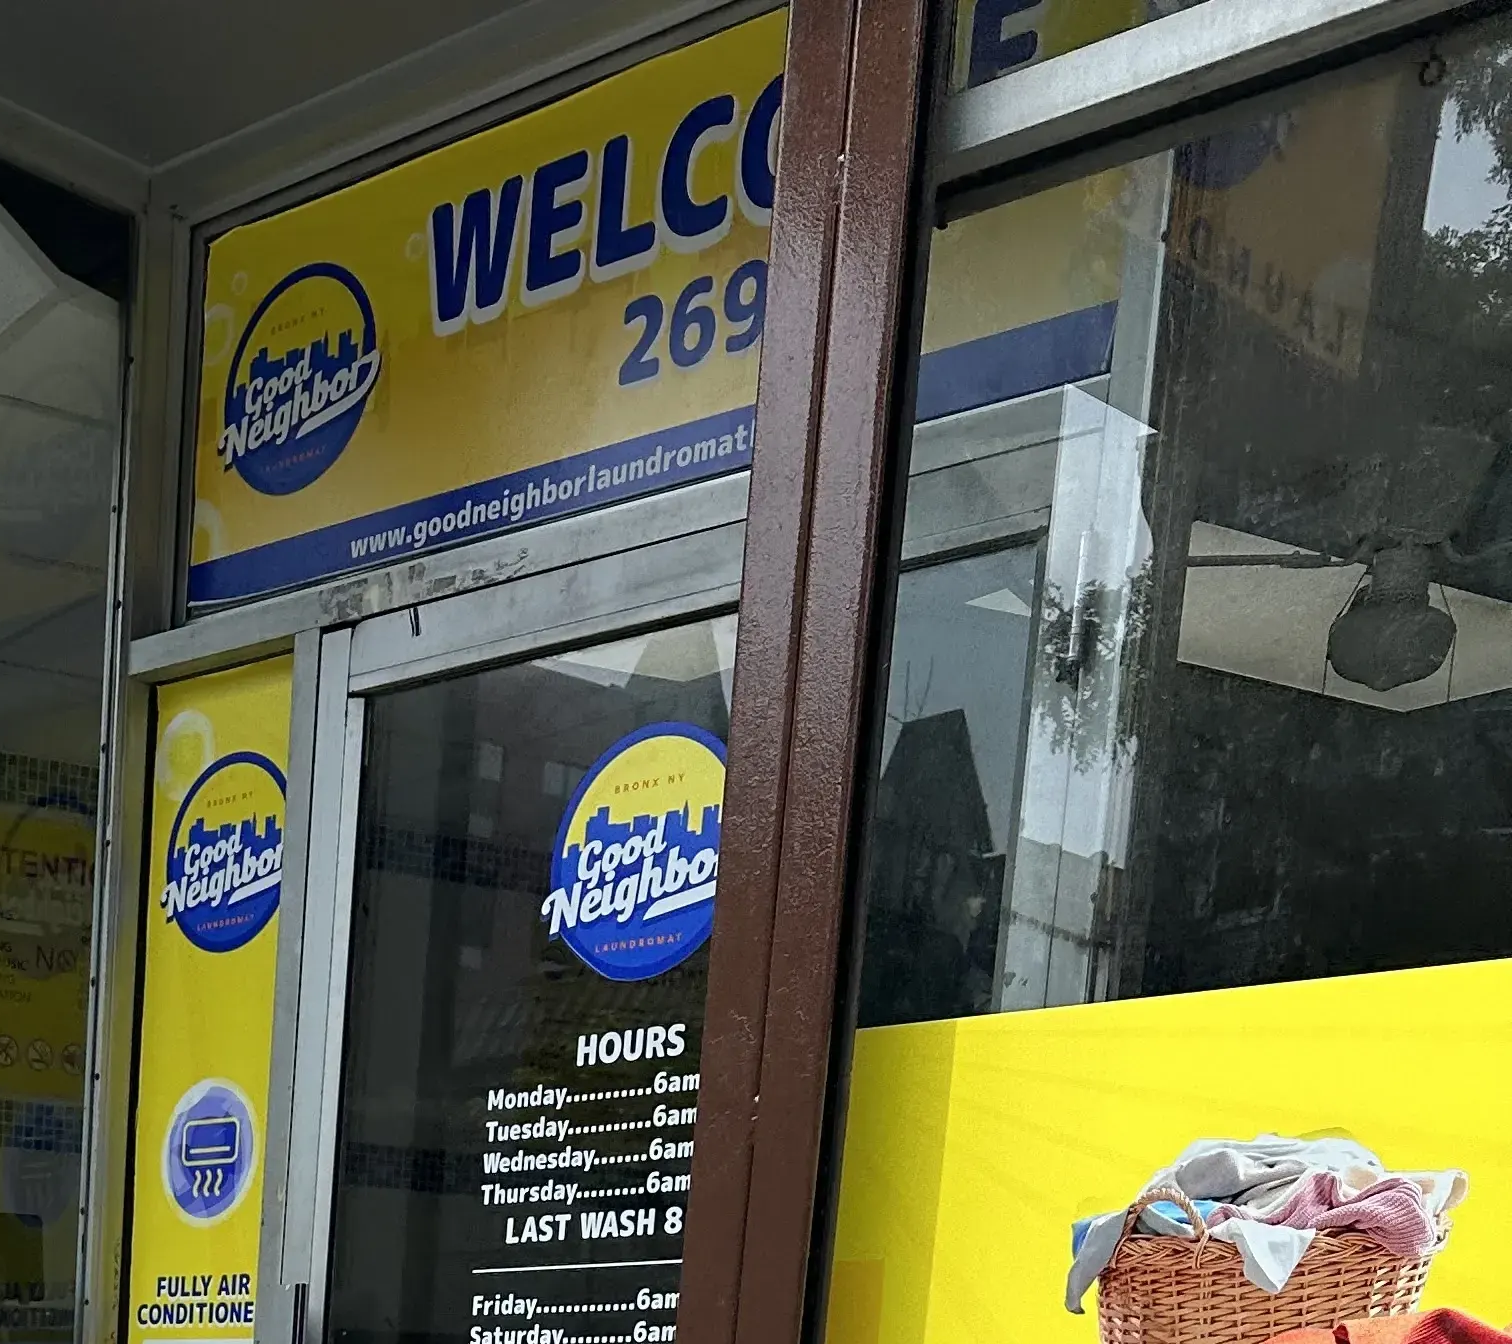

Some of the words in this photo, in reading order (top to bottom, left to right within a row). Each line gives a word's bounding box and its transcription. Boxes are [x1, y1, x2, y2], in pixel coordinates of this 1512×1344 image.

[619, 258, 769, 387] 269
[219, 350, 380, 465] Neighbor
[244, 346, 313, 421] Good
[349, 422, 755, 560] www.goodneighborlaundromat
[613, 777, 660, 795] BRONX
[667, 773, 686, 785] NY
[183, 823, 244, 882] Good
[577, 814, 667, 888] Good
[595, 932, 683, 954] LAUNDROMAT
[575, 1023, 686, 1068] HOURS
[505, 1212, 572, 1246] LAST
[580, 1207, 656, 1241] WASH
[664, 1206, 684, 1235] 8
[156, 1274, 213, 1299] FULLY
[217, 1272, 251, 1297] AIR
[136, 1300, 255, 1327] CONDITIONE
